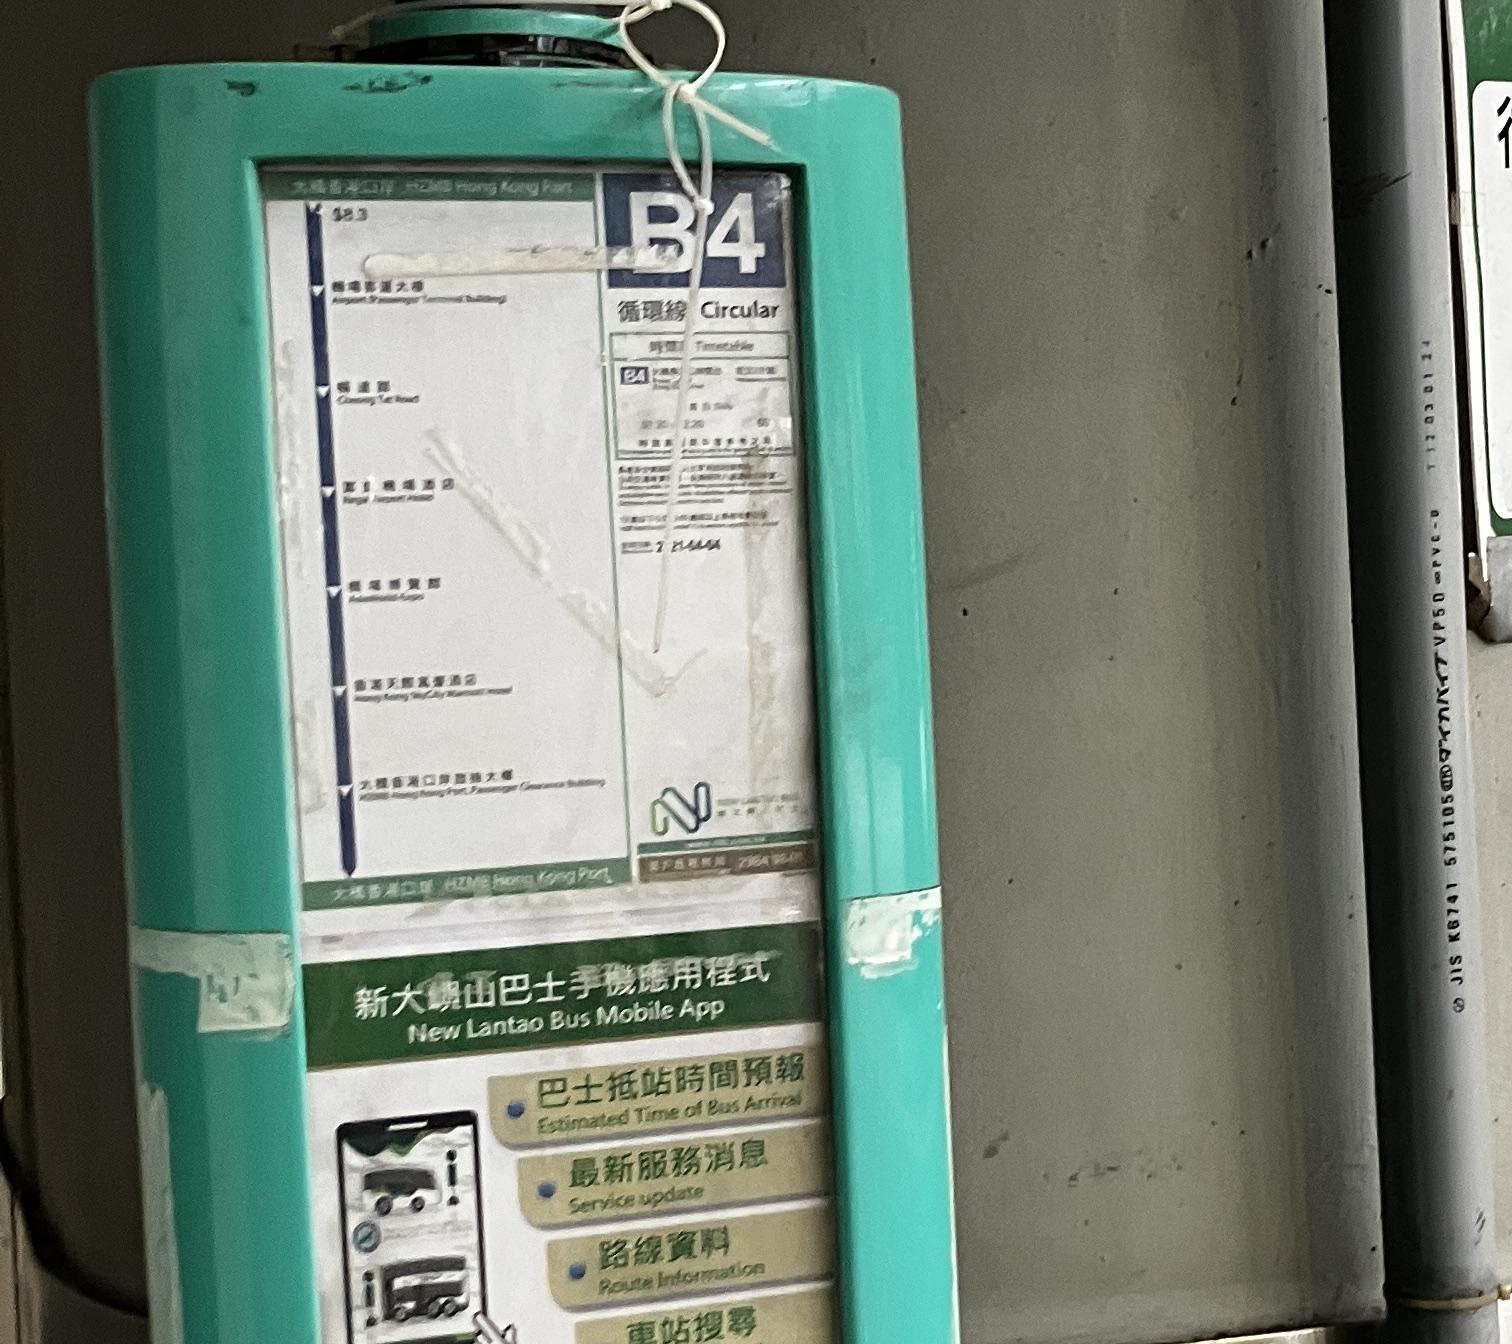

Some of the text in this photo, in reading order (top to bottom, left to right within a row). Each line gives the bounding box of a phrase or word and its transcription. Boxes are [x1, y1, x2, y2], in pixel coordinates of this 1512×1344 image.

[629, 191, 766, 274] B4
[700, 299, 780, 319] Circular
[407, 997, 726, 1044] New Lantao Bus Mobile App
[634, 1104, 679, 1124] Time
[684, 1099, 704, 1118] of
[568, 1185, 705, 1215] Service update
[600, 1262, 766, 1296] Route Information
